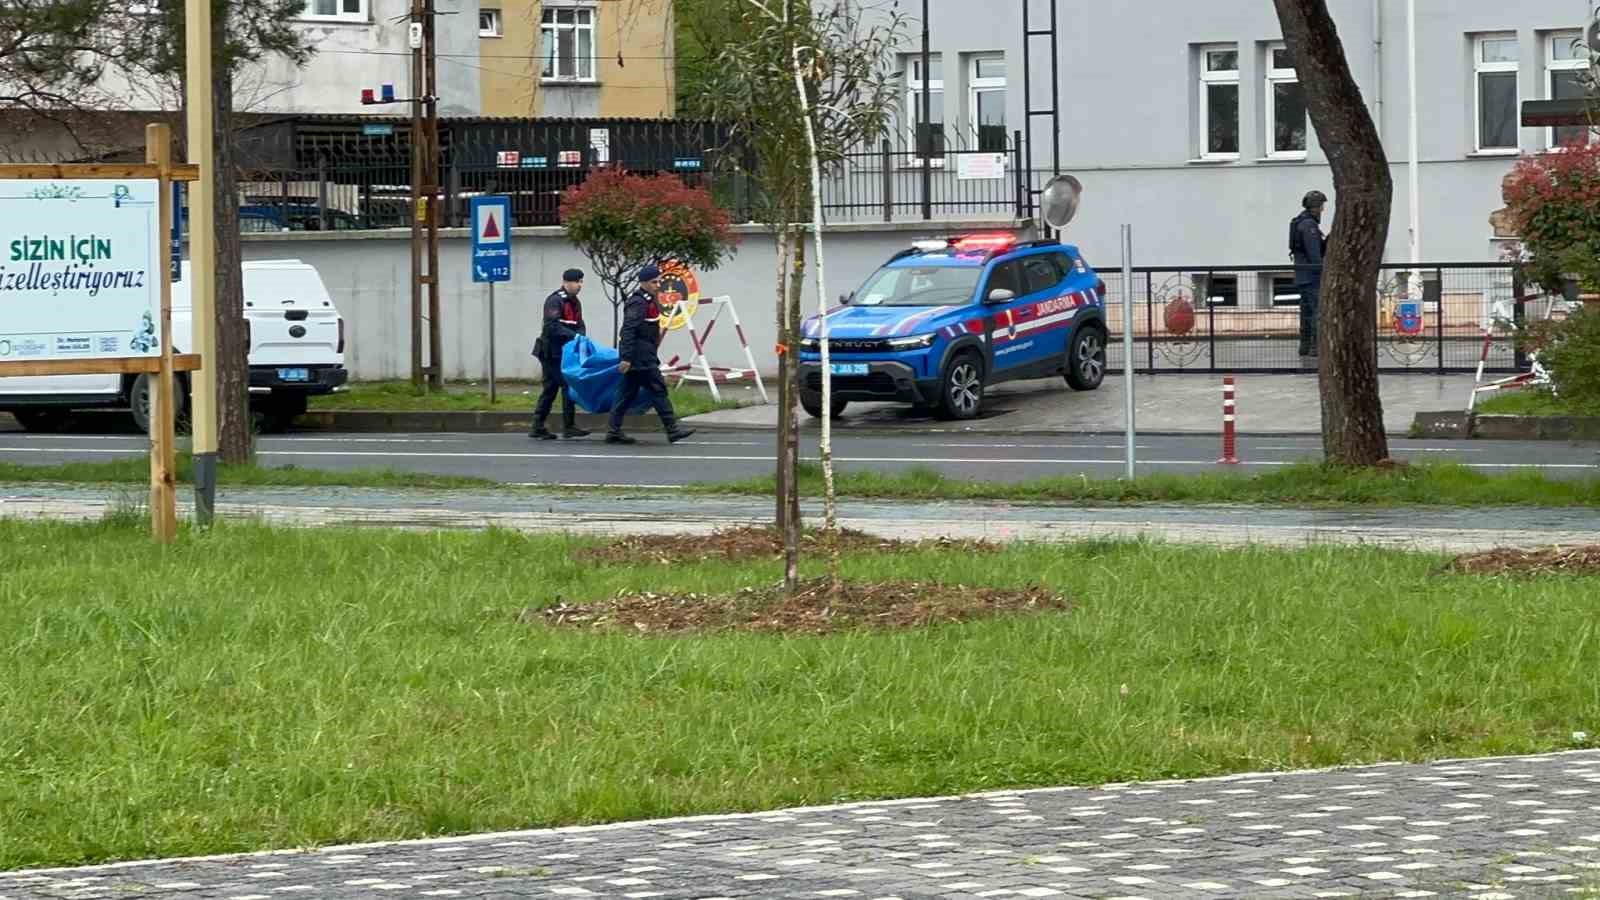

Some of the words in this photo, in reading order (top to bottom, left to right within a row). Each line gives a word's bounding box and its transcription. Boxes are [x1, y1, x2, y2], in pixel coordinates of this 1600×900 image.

[11, 235, 64, 261] SİZİN
[71, 234, 111, 264] İÇİN
[493, 266, 508, 276] 112
[1036, 294, 1077, 316] JANDARMA
